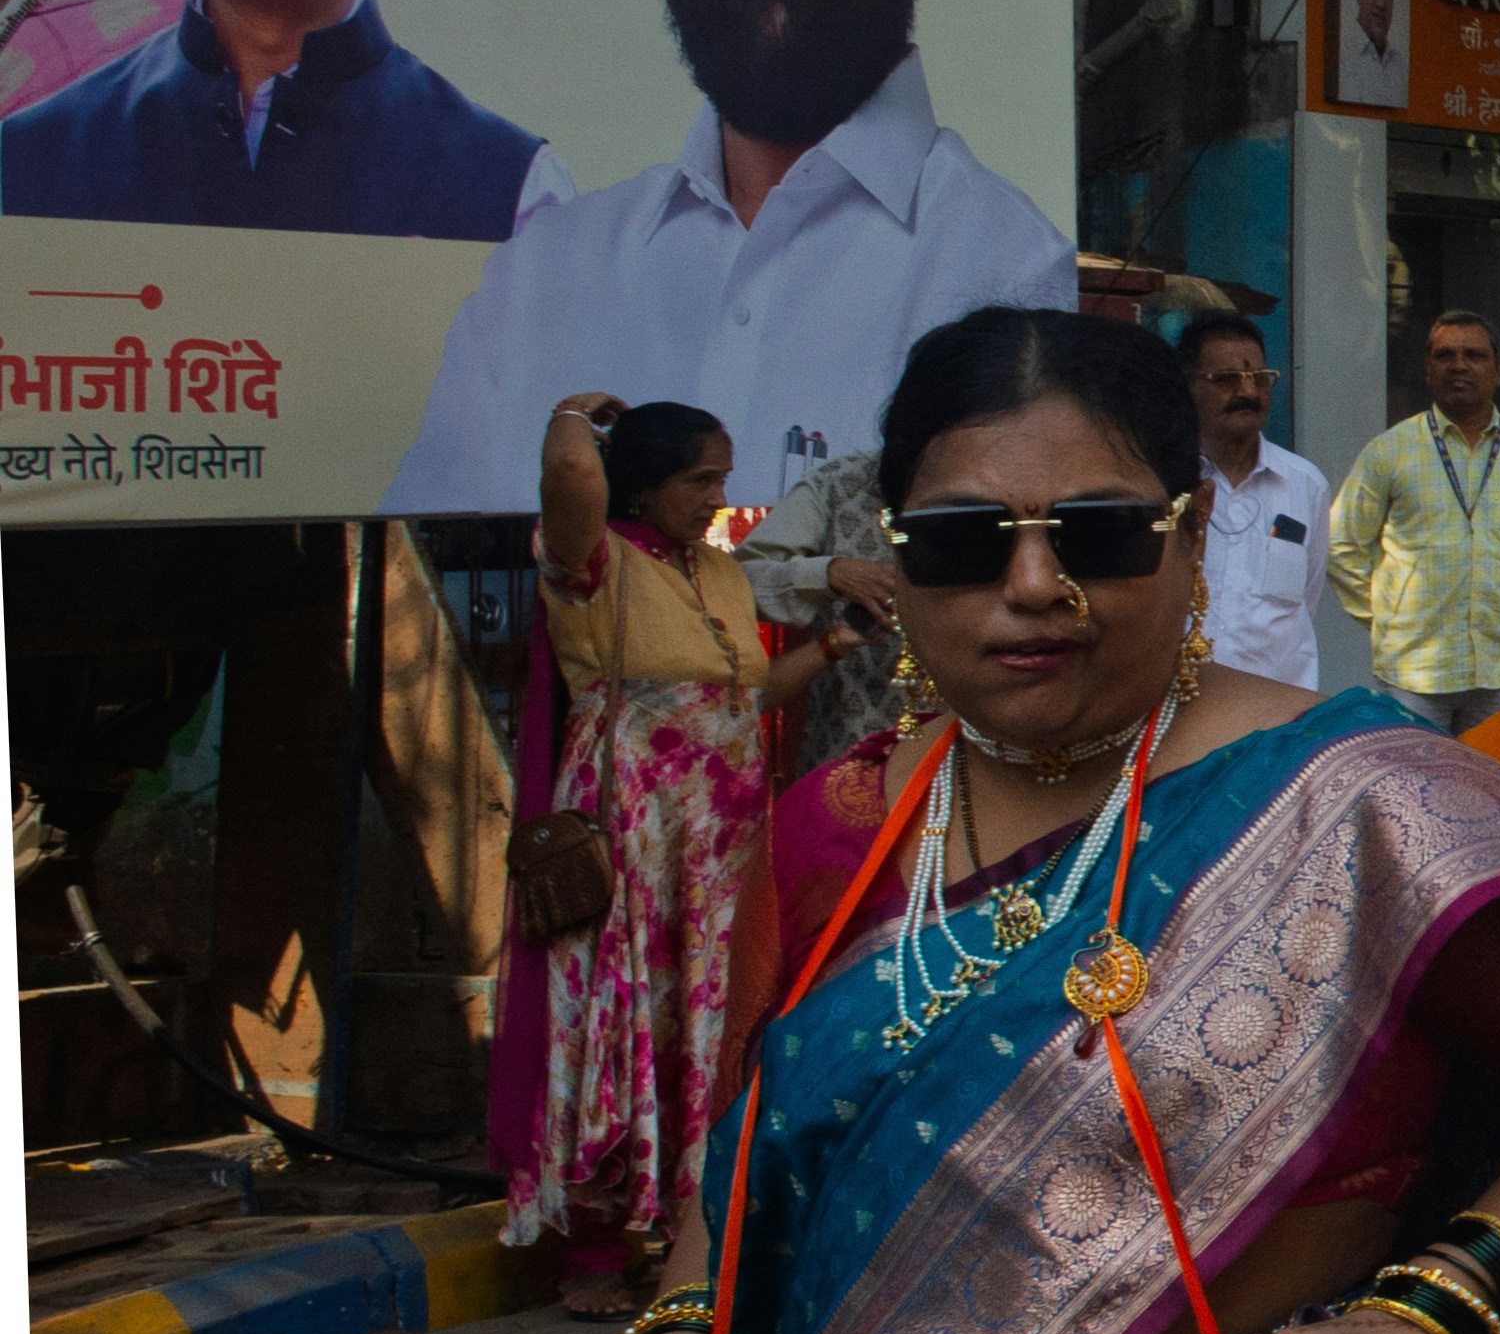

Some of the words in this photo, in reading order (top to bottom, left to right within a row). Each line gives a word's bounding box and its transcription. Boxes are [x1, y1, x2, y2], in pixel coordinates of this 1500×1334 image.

[1443, 84, 1474, 117] श्री.
[0, 335, 152, 412] भाजी
[163, 338, 282, 418] शिंदे
[0, 445, 54, 481] ख्य
[62, 434, 124, 486] नेते,
[132, 434, 265, 480] शिवसेना
